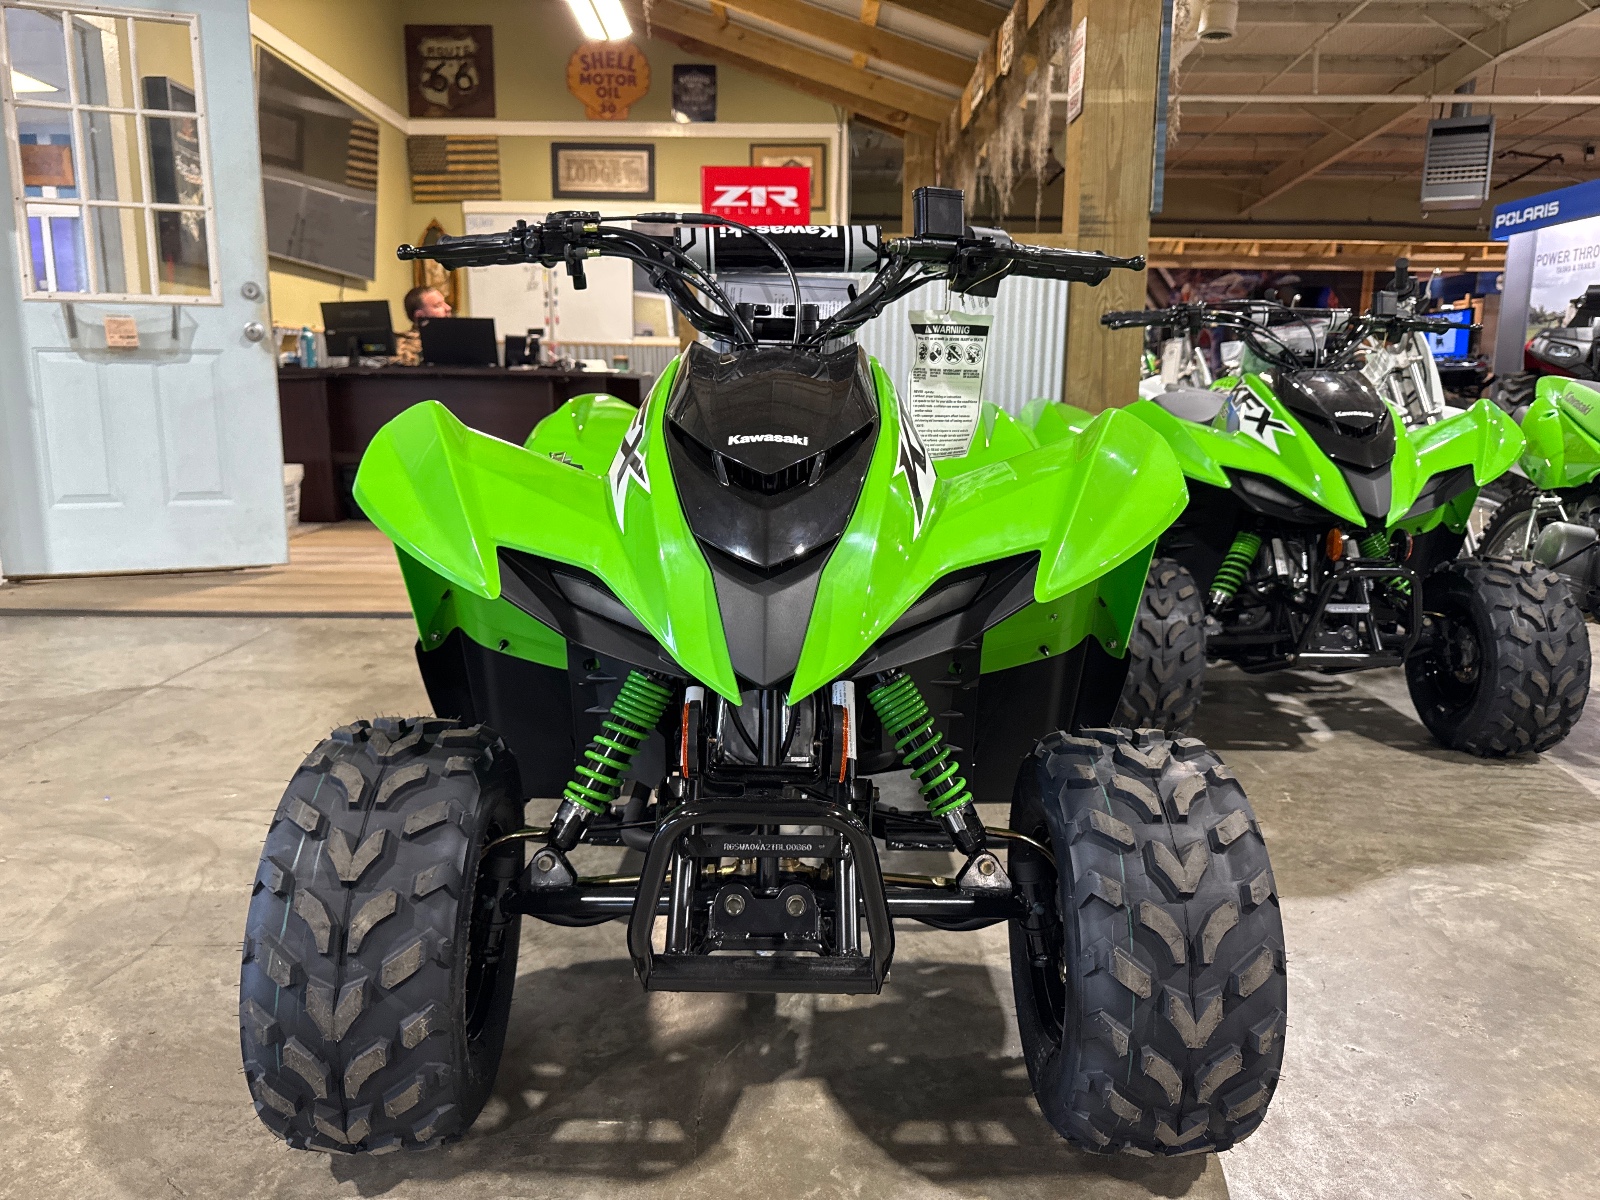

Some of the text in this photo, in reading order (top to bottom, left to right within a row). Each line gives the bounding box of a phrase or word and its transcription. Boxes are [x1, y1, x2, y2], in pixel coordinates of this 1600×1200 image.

[426, 44, 472, 56] ROUTE
[579, 50, 637, 73] SHELL
[429, 61, 474, 93] 66
[579, 73, 638, 87] MOTOR
[595, 86, 621, 99] OIL
[711, 185, 800, 208] Z1R
[1494, 200, 1560, 229] POLARIS
[1536, 249, 1571, 267] POWER
[932, 325, 971, 335] WARNING
[727, 433, 809, 447] Kawasaki
